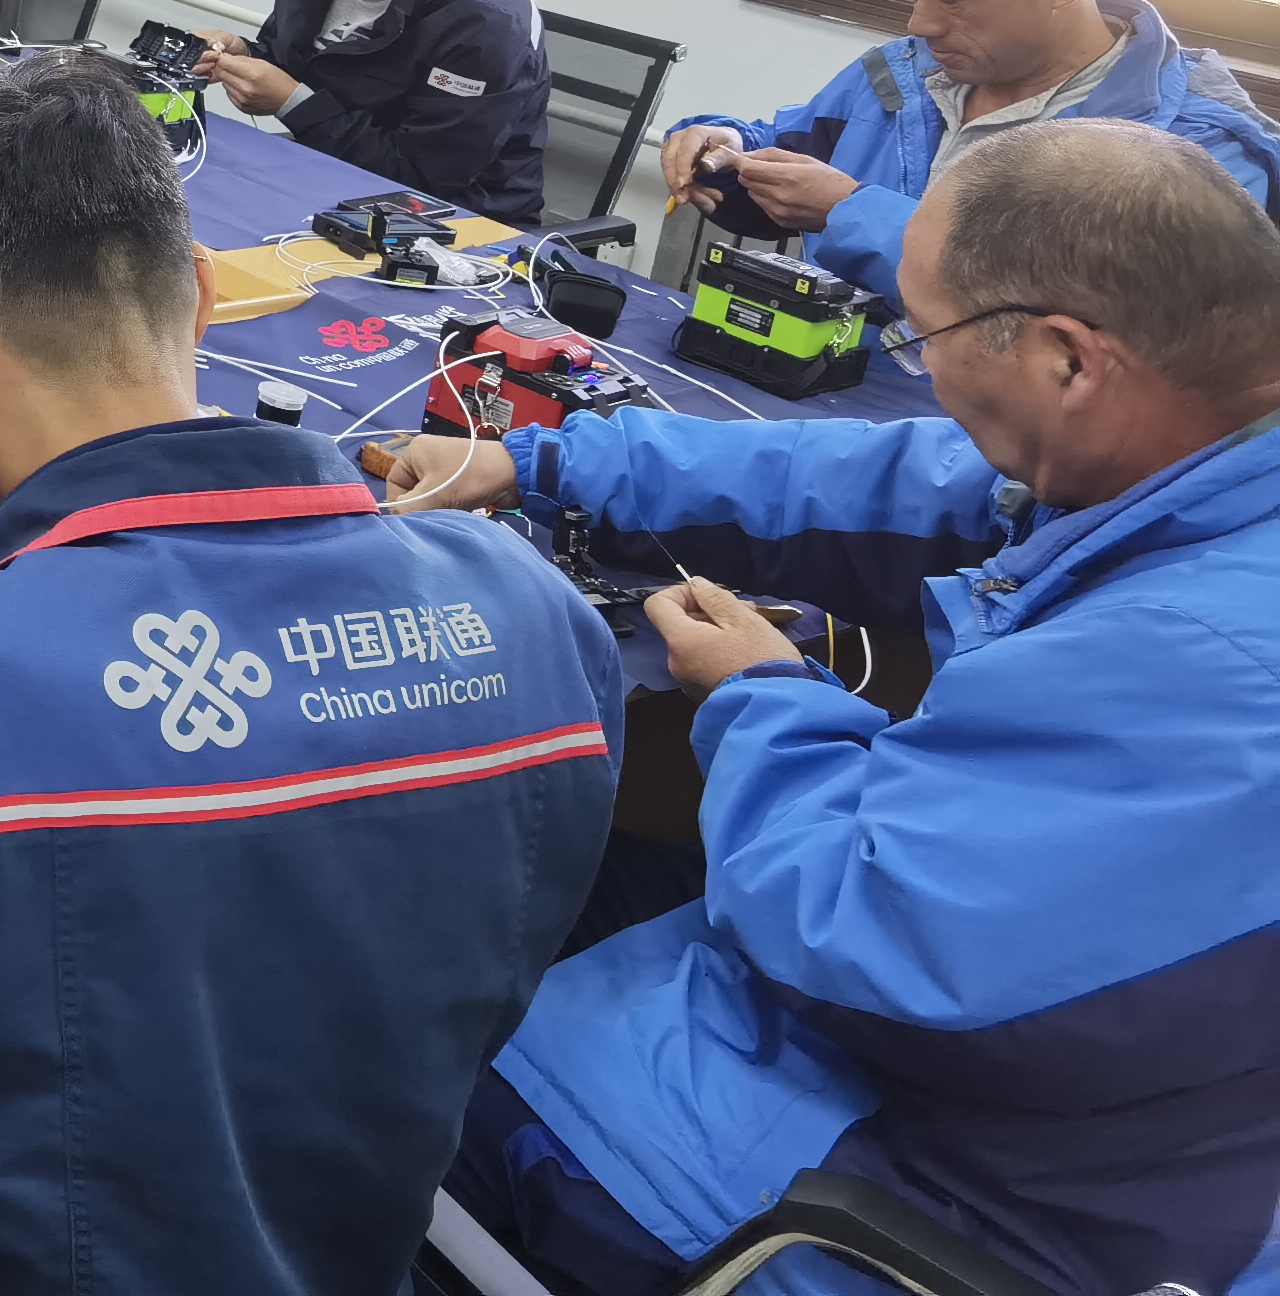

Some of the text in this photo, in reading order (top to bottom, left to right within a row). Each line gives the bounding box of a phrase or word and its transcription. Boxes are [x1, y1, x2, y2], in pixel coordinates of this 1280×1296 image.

[277, 602, 497, 676] 中国联通
[299, 670, 507, 723] China unicom
